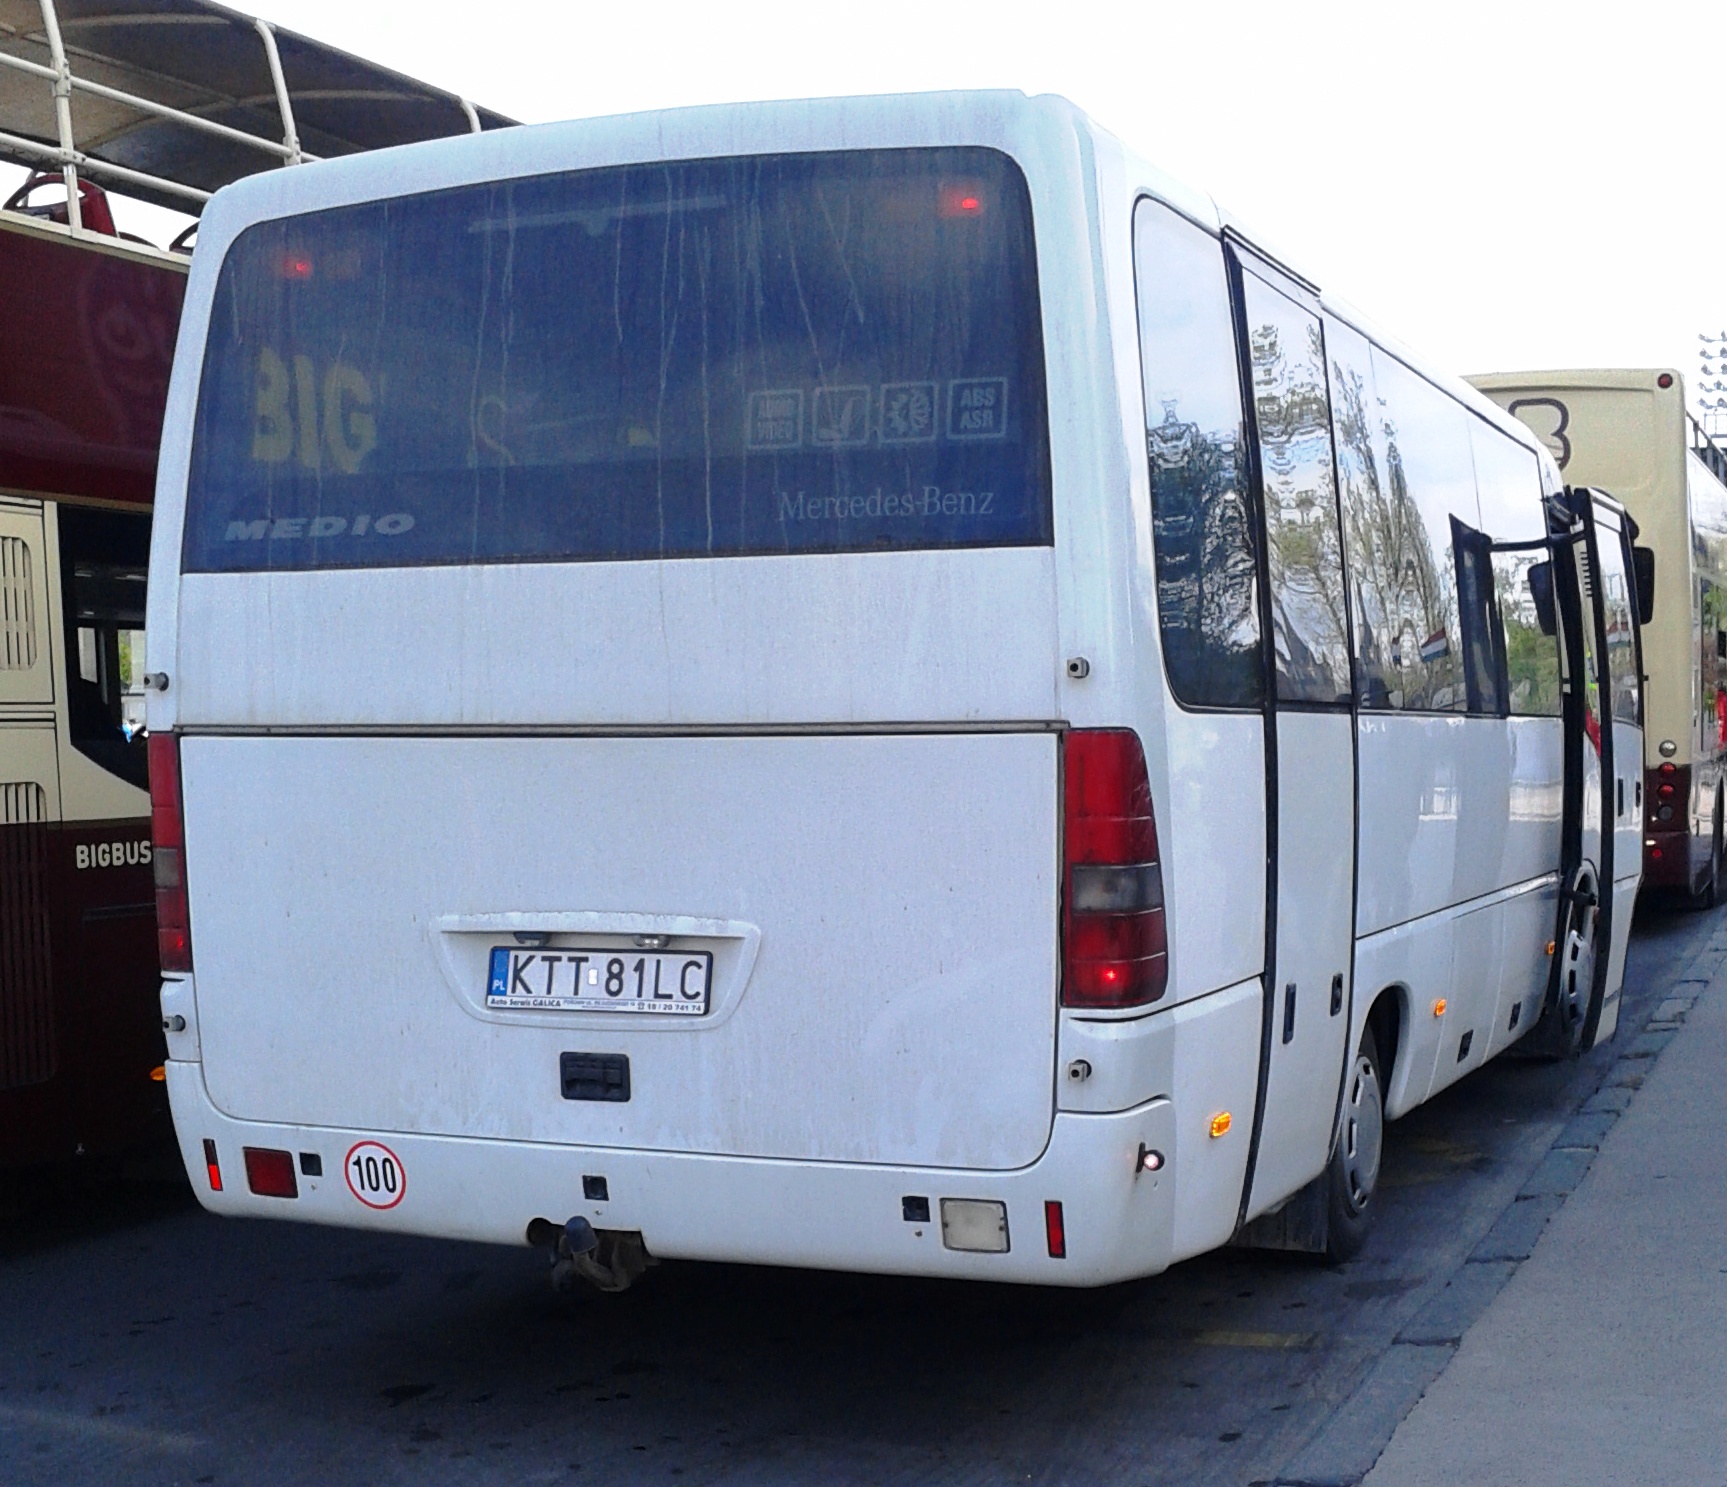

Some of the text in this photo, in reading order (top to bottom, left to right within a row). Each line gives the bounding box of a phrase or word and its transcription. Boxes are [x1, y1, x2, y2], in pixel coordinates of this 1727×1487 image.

[251, 344, 377, 475] BIG
[960, 387, 996, 408] ABS
[960, 409, 993, 429] ASR
[777, 485, 995, 522] Mercedes-Benz
[224, 512, 416, 542] MEDIO
[74, 839, 152, 870] BIGBUS
[491, 979, 506, 991] PL
[510, 953, 703, 1001] KTT 81LC
[352, 1155, 397, 1194] 100
